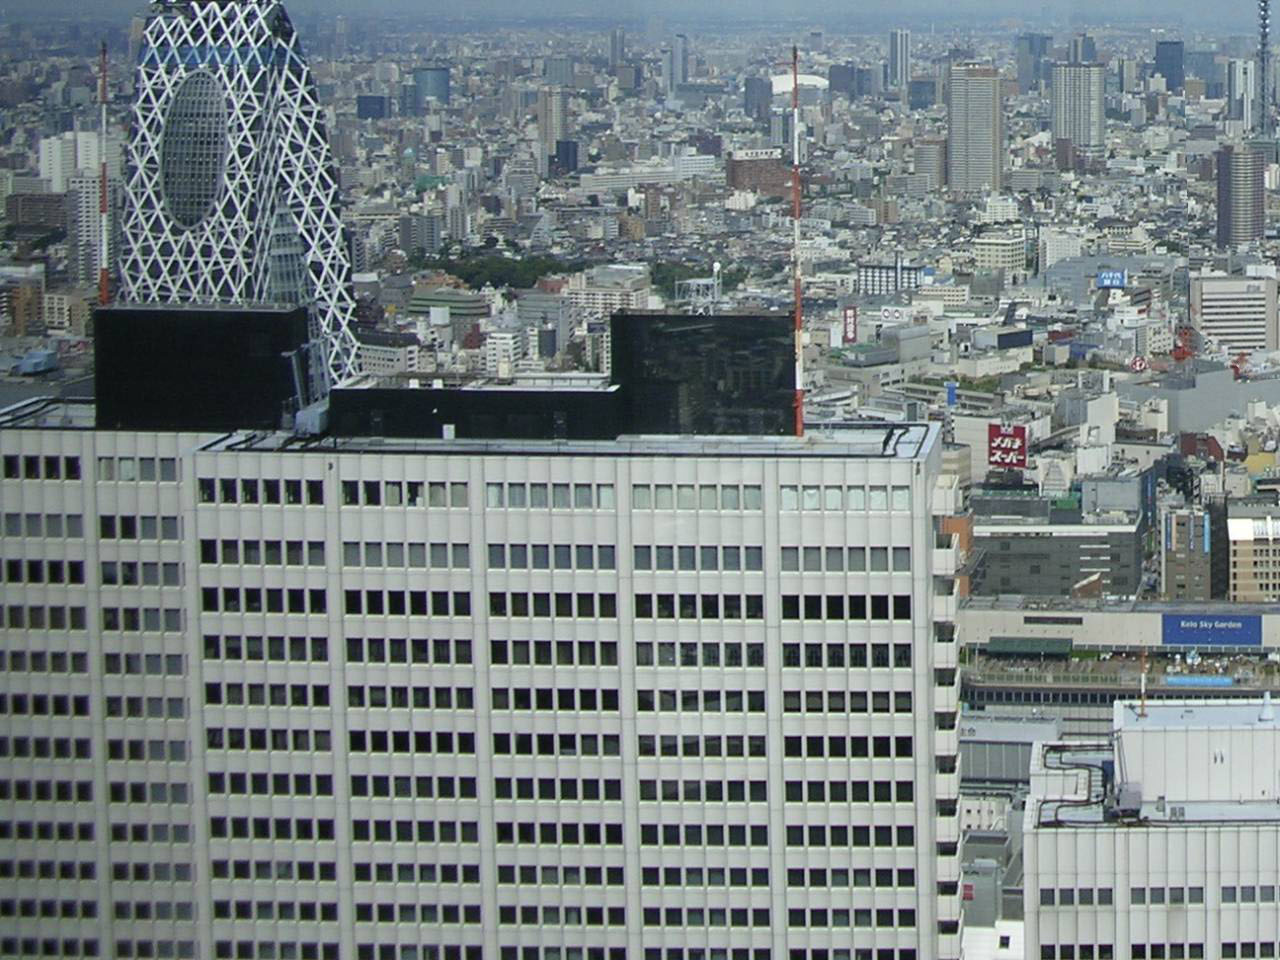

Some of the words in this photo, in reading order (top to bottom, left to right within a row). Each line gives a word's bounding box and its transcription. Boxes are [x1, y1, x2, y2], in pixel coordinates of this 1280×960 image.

[990, 450, 1025, 463] スーパー
[1199, 620, 1213, 630] Sky
[1214, 620, 1242, 629] Garden
